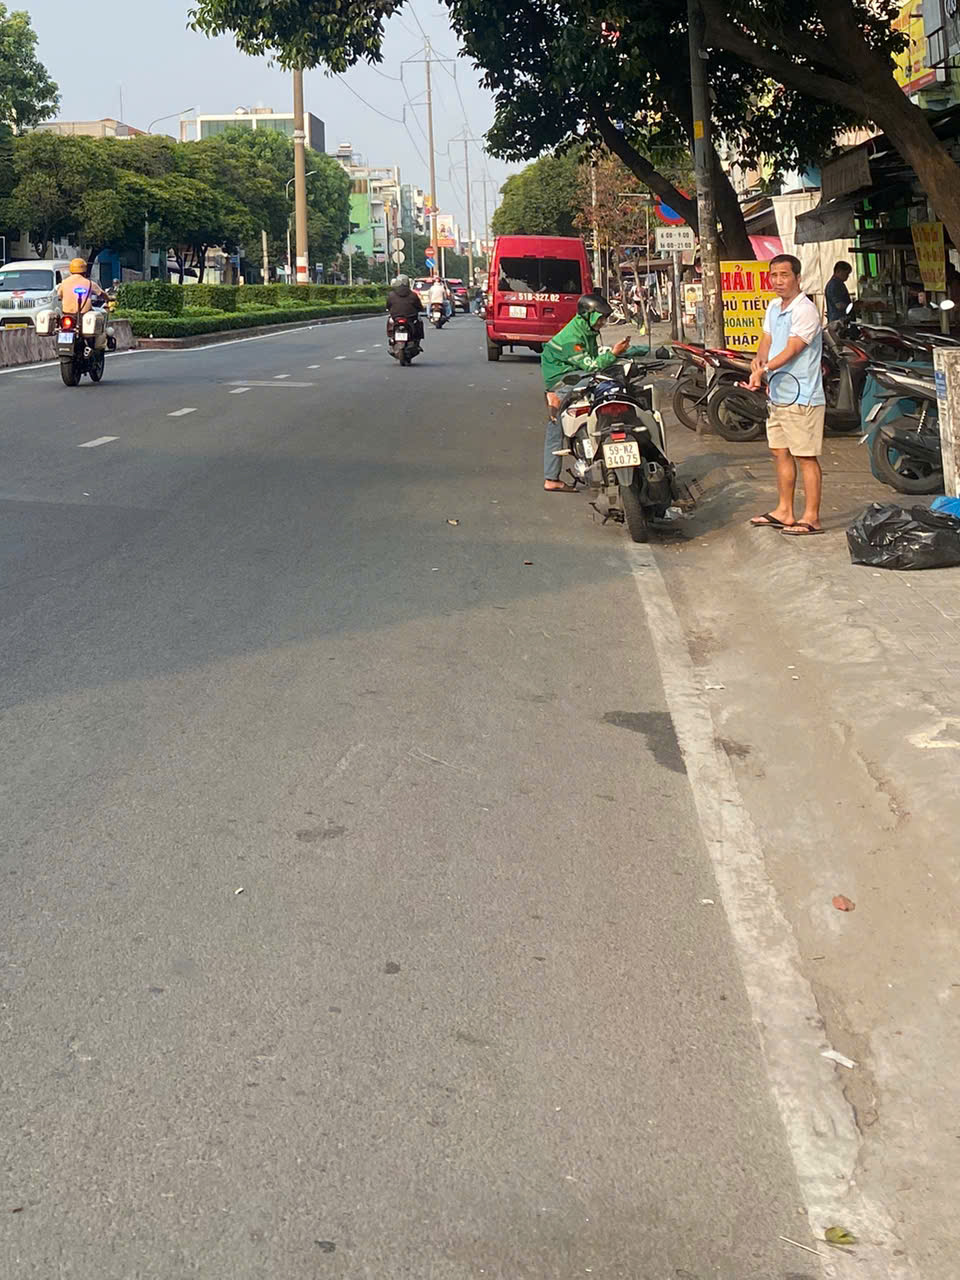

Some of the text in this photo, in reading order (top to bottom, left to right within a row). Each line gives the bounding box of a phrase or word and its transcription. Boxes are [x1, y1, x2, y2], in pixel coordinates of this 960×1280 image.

[759, 271, 774, 291] K
[741, 295, 770, 311] TIẾU
[724, 332, 759, 347] THẬP
